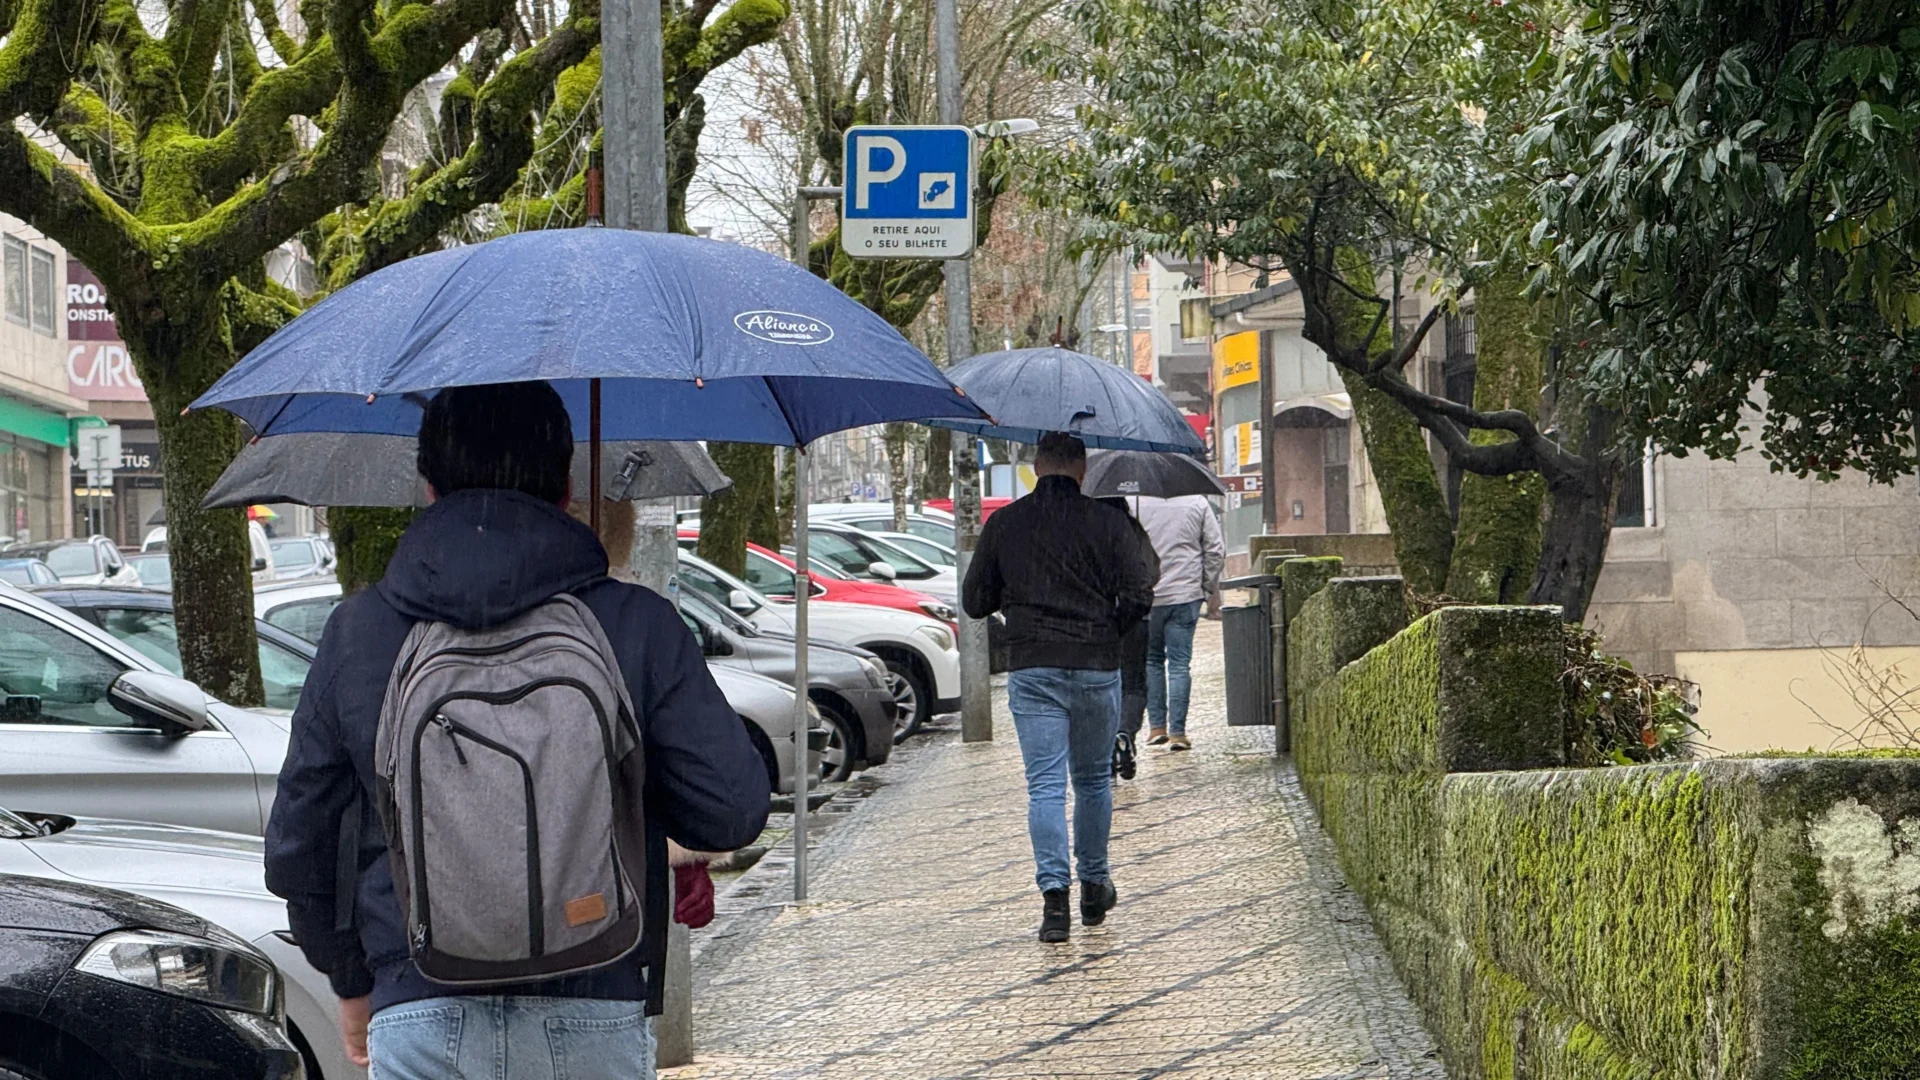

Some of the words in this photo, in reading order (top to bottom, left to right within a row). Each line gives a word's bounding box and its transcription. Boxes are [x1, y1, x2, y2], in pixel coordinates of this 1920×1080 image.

[855, 135, 907, 210] P
[872, 226, 909, 235] RETIRE
[914, 226, 940, 235] AQUI
[865, 239, 873, 248] O
[878, 239, 899, 248] SEU
[905, 239, 948, 248] BILHETE
[745, 314, 821, 333] Aliança
